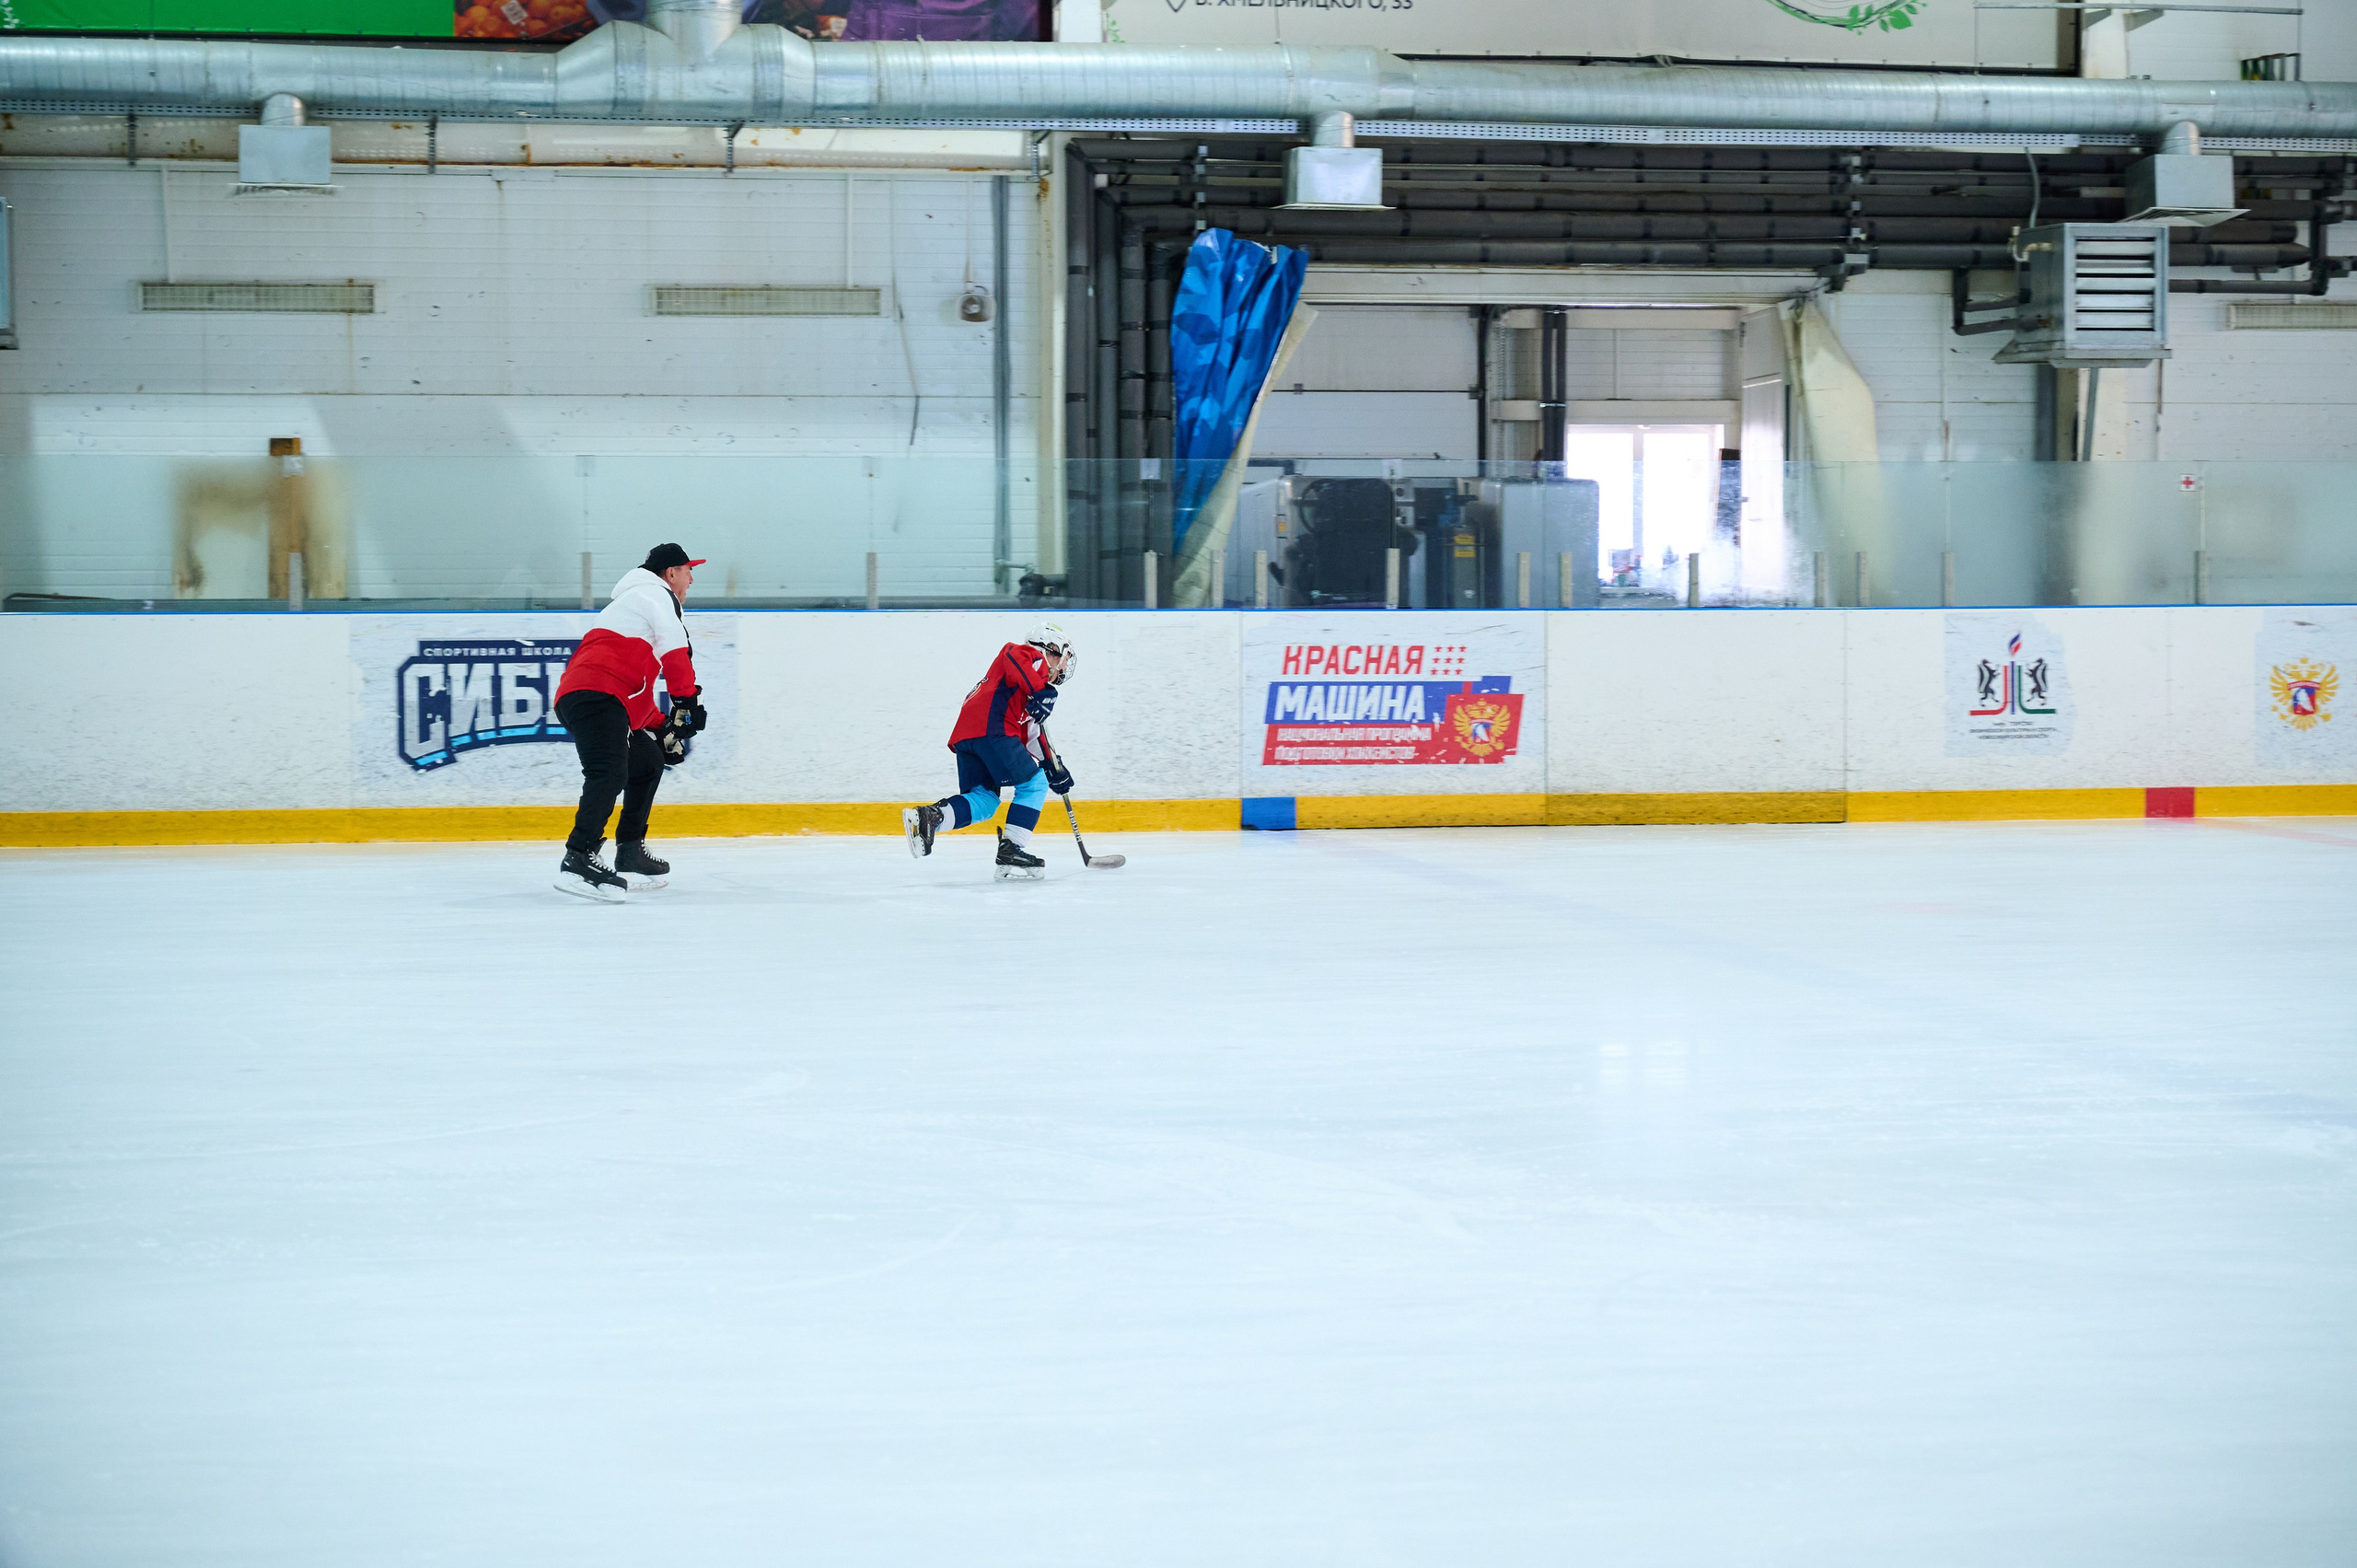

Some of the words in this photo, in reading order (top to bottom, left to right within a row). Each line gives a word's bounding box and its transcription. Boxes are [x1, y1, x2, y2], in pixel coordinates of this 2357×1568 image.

[423, 647, 516, 656] СПОРТИВНАЯ
[521, 646, 573, 656] ШКОЛА
[1282, 645, 1425, 675] КРАСНАЯ
[1274, 685, 1426, 721] МАШИНА
